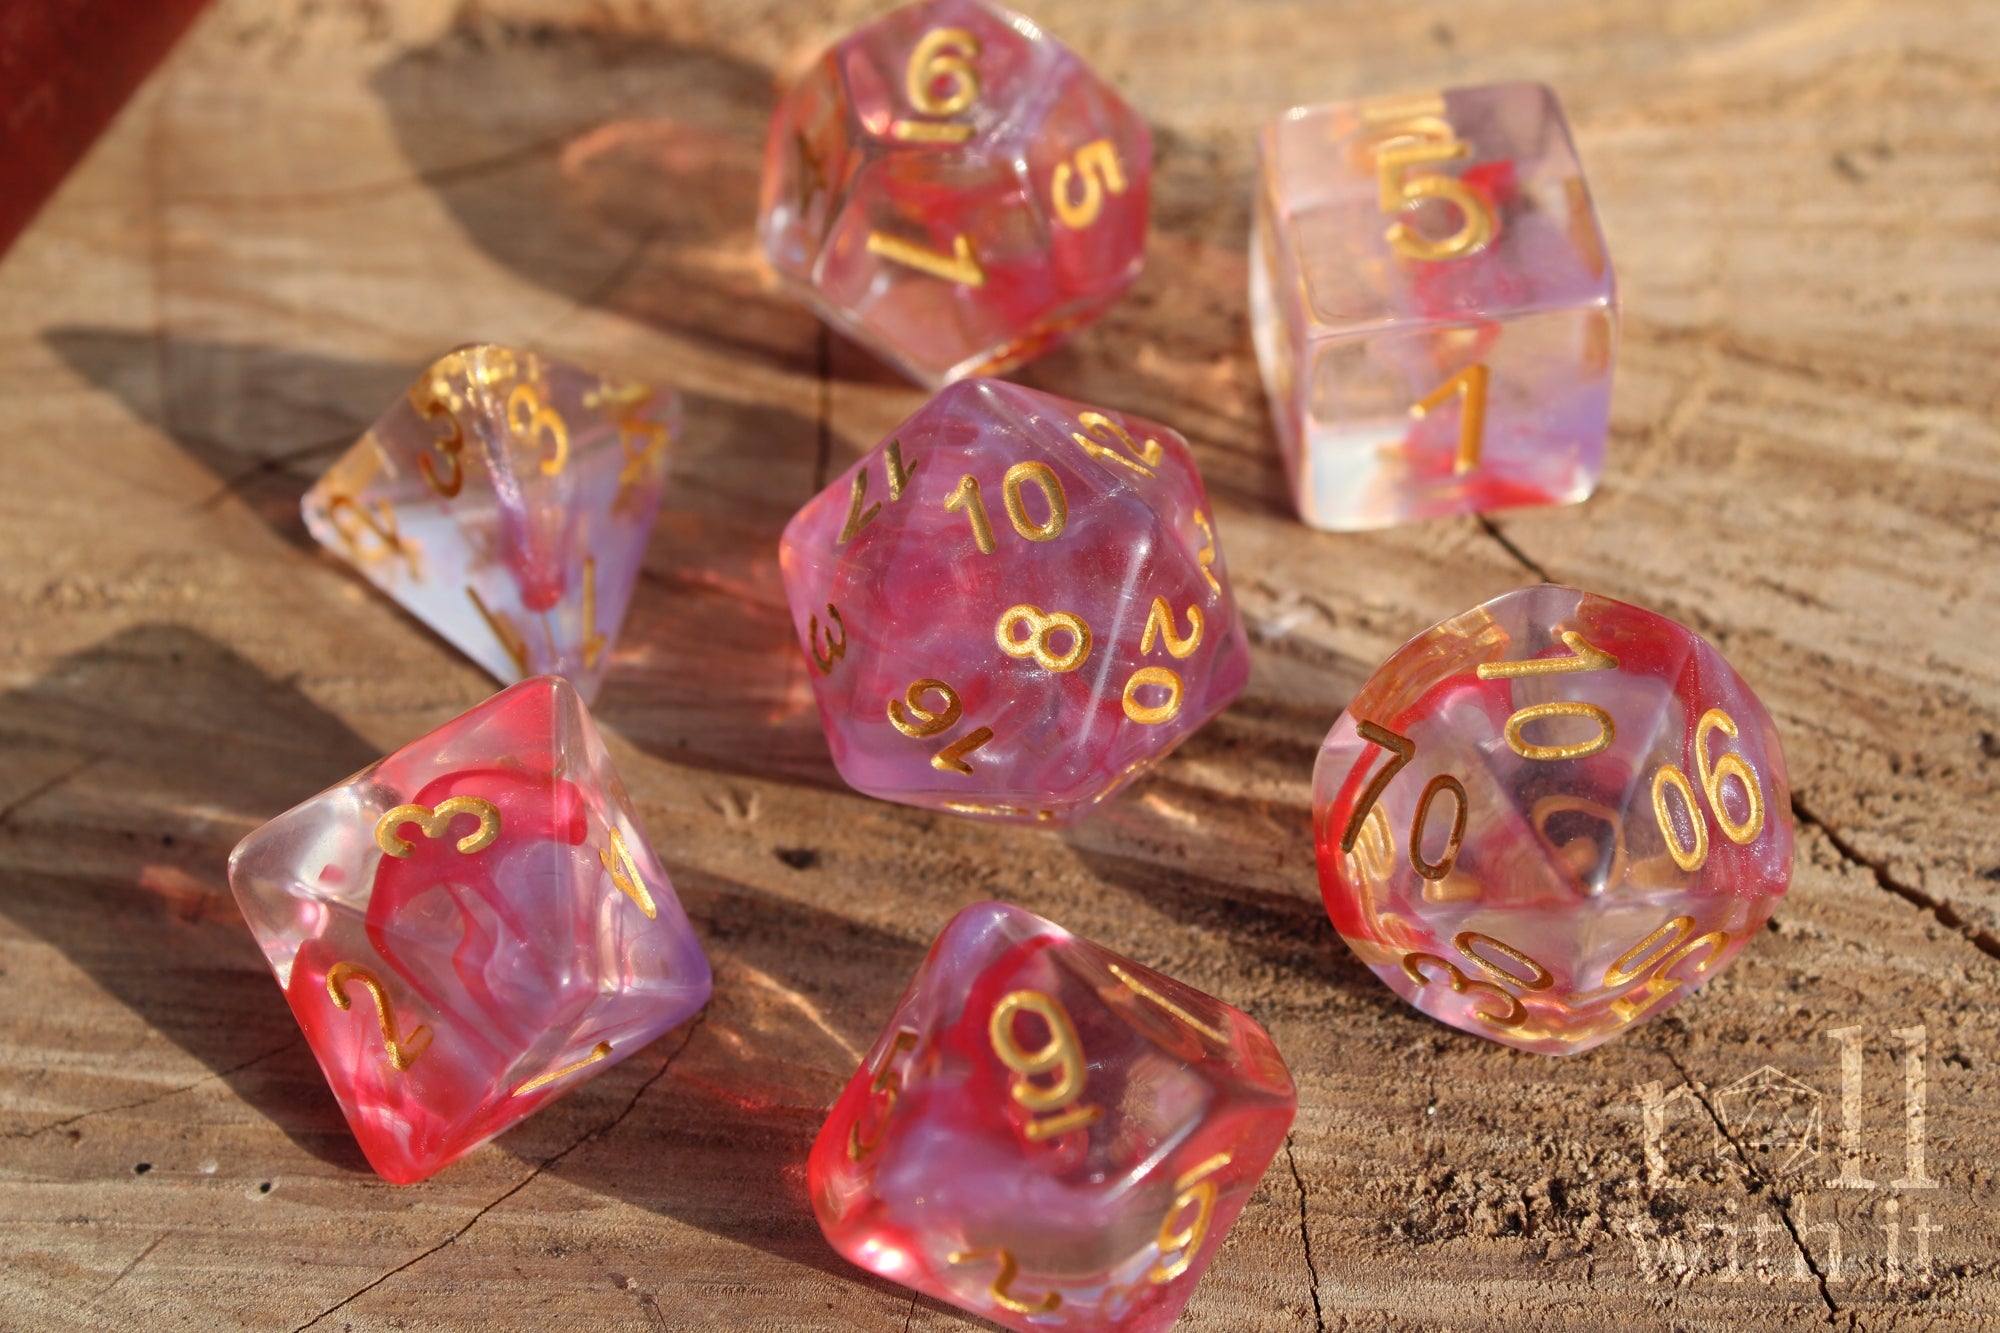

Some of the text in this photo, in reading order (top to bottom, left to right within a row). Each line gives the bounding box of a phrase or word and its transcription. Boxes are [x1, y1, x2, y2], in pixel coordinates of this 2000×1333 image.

[1051, 139, 1127, 229] 5
[1378, 143, 1495, 260] 5
[866, 232, 984, 286] 1
[1072, 412, 1163, 478] 12
[1410, 364, 1490, 474] 1
[945, 461, 1068, 554] 10
[810, 603, 846, 676] 3
[997, 604, 1092, 673] 8
[1122, 596, 1204, 724] 20
[888, 678, 994, 776] 16
[375, 796, 500, 858] 3
[326, 962, 434, 1071] 2
